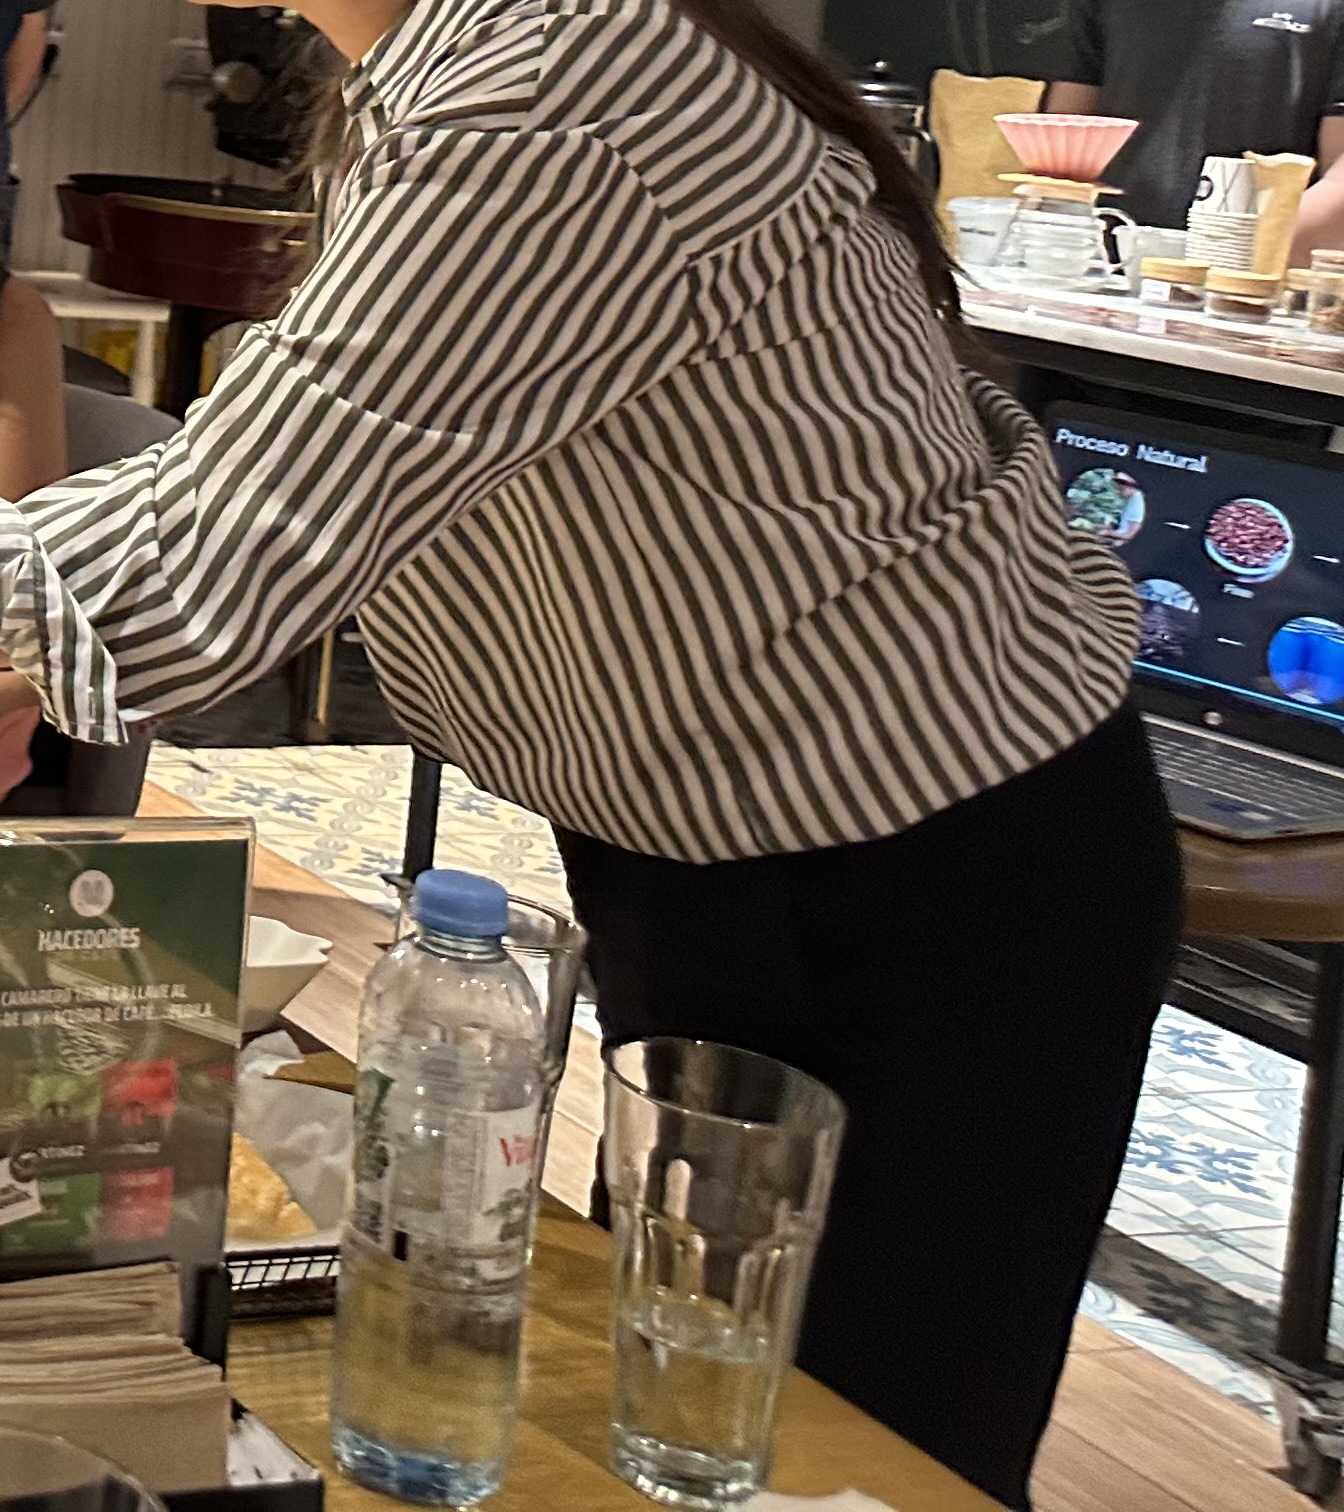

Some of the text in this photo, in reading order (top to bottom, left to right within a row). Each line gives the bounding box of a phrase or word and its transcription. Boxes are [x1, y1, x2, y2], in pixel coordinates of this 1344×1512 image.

[1055, 428, 1209, 473] Proceso Natural
[37, 926, 142, 952] HACEDORES
